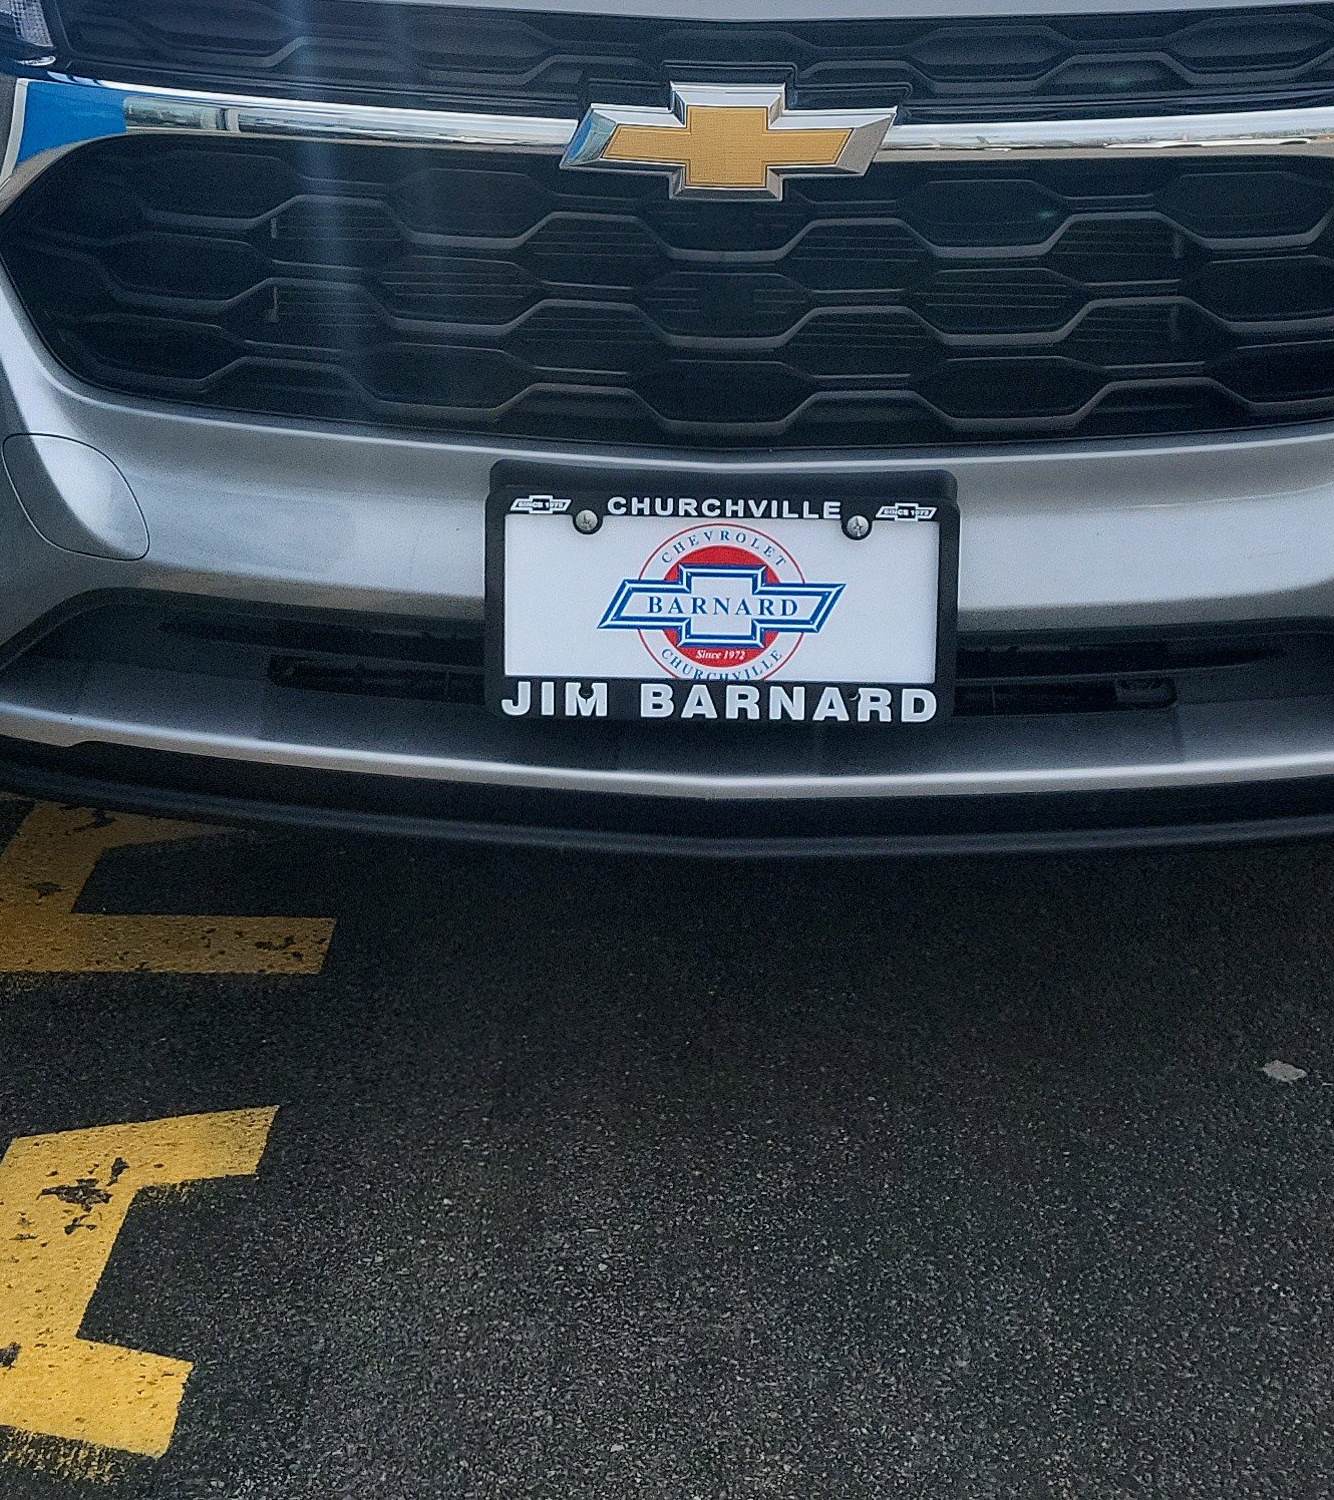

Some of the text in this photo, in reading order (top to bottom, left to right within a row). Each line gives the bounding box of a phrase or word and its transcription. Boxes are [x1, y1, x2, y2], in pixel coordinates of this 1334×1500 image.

[607, 496, 841, 519] CHURCHVILLE
[661, 529, 787, 567] CHEVROLET
[648, 595, 799, 617] BARNARD
[661, 648, 783, 680] CHURCHVILLE
[695, 648, 746, 660] Since 1972
[501, 681, 937, 722] JIM BARNARD
